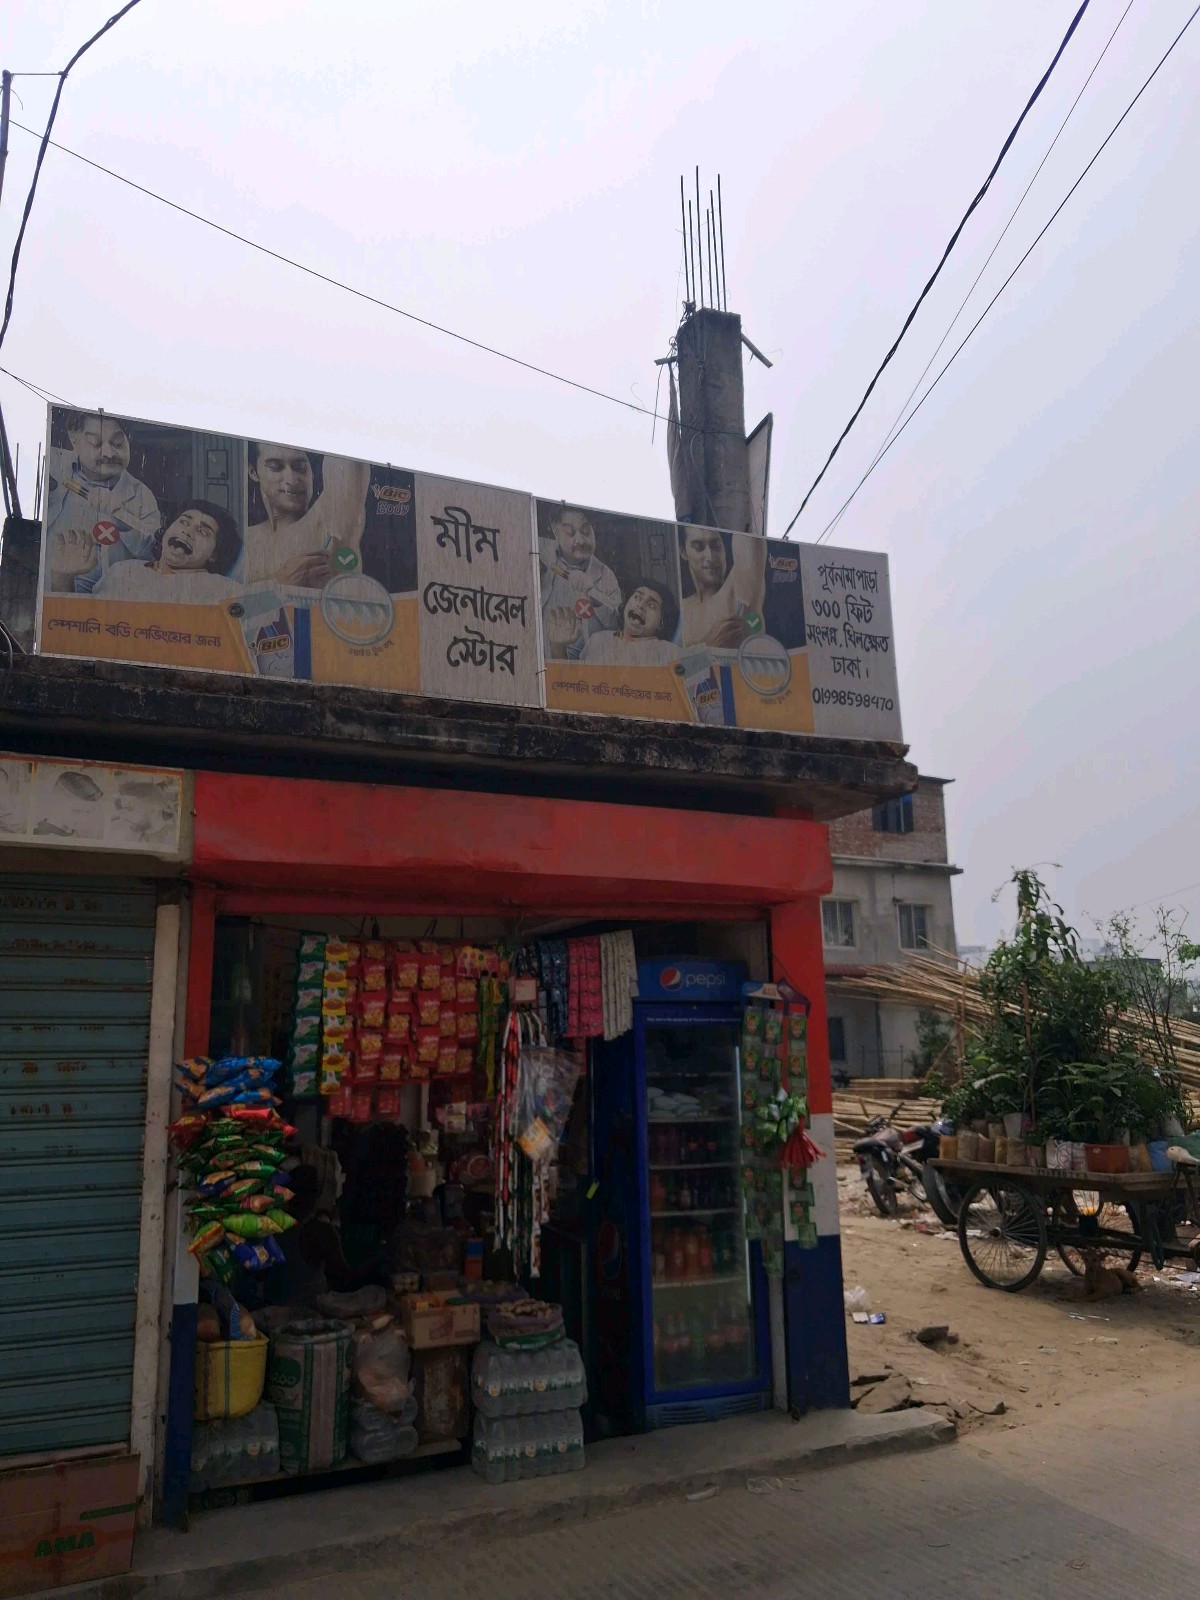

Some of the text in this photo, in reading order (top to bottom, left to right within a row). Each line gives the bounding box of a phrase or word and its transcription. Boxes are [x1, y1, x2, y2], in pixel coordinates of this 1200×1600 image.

[382, 488, 409, 500] BIC
[377, 501, 409, 515] Body
[430, 506, 500, 563] মীম
[423, 582, 527, 628] জেনারেল
[811, 594, 874, 624] ৩০০ ফিট
[48, 618, 100, 634] স্পেশালি
[105, 622, 131, 638] বডি
[195, 634, 222, 648] জন্য
[260, 637, 289, 652] BIC
[446, 625, 518, 676] স্টোর
[812, 687, 894, 712] 01998598470
[686, 973, 726, 988] pepsi
